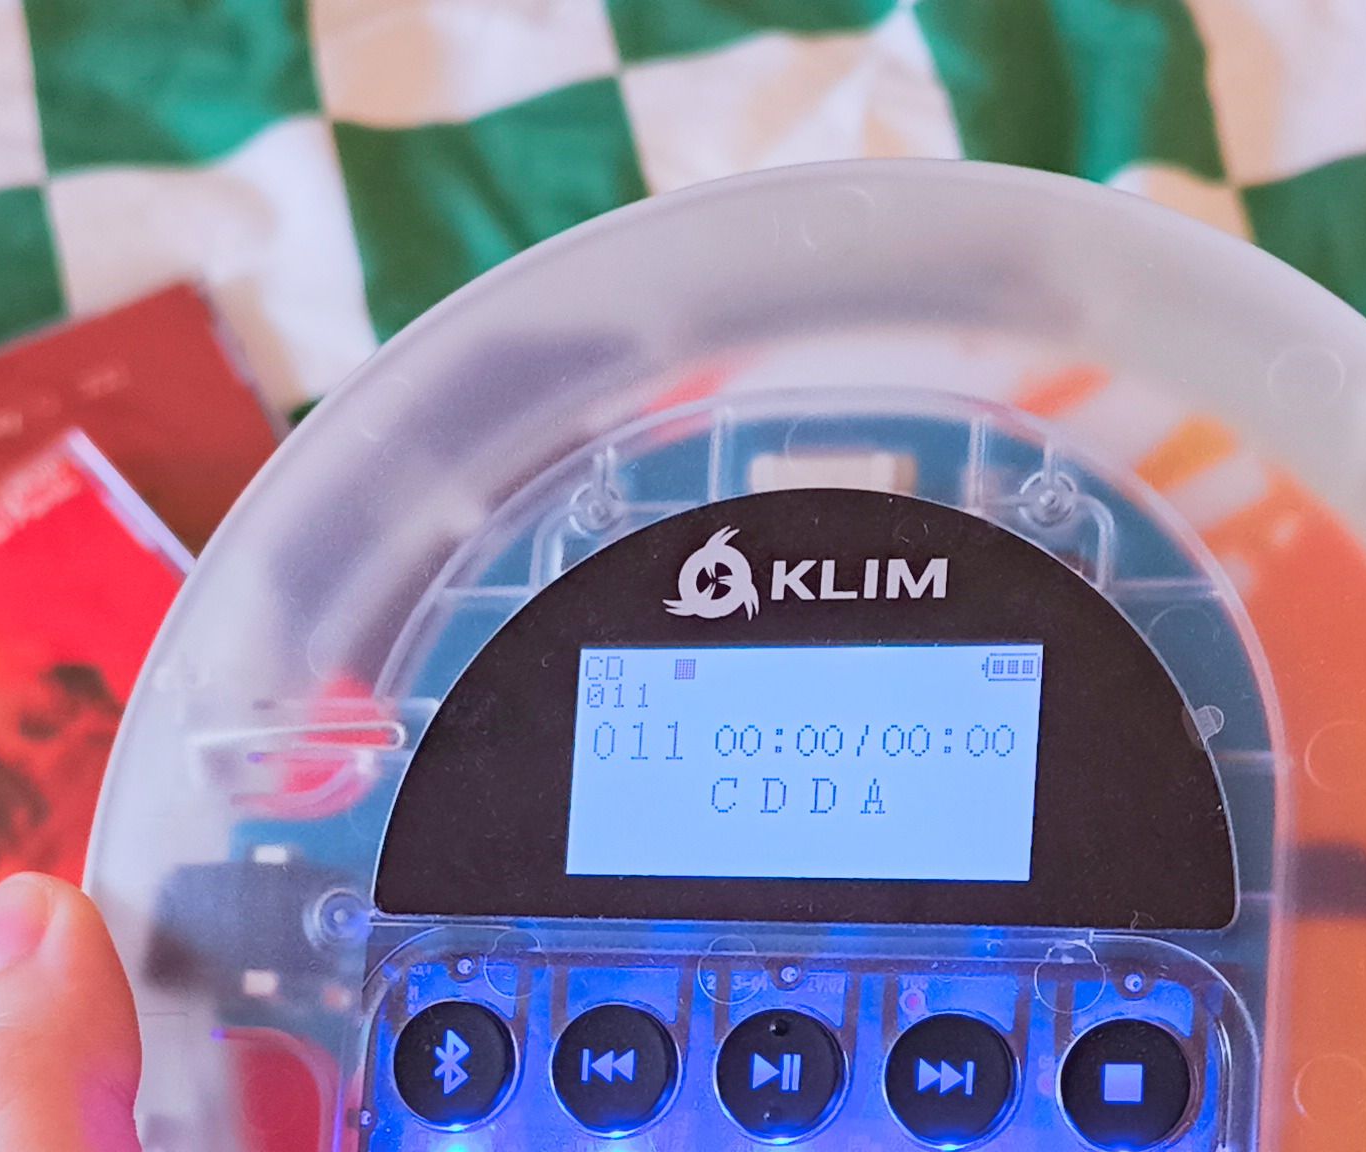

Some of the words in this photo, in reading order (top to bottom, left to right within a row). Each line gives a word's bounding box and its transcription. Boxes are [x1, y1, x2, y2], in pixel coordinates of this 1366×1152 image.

[771, 558, 949, 601] KLIM
[585, 655, 624, 681] CD
[586, 683, 649, 709] 011
[593, 721, 684, 760] 011
[715, 724, 1016, 757] 00:00/00:00
